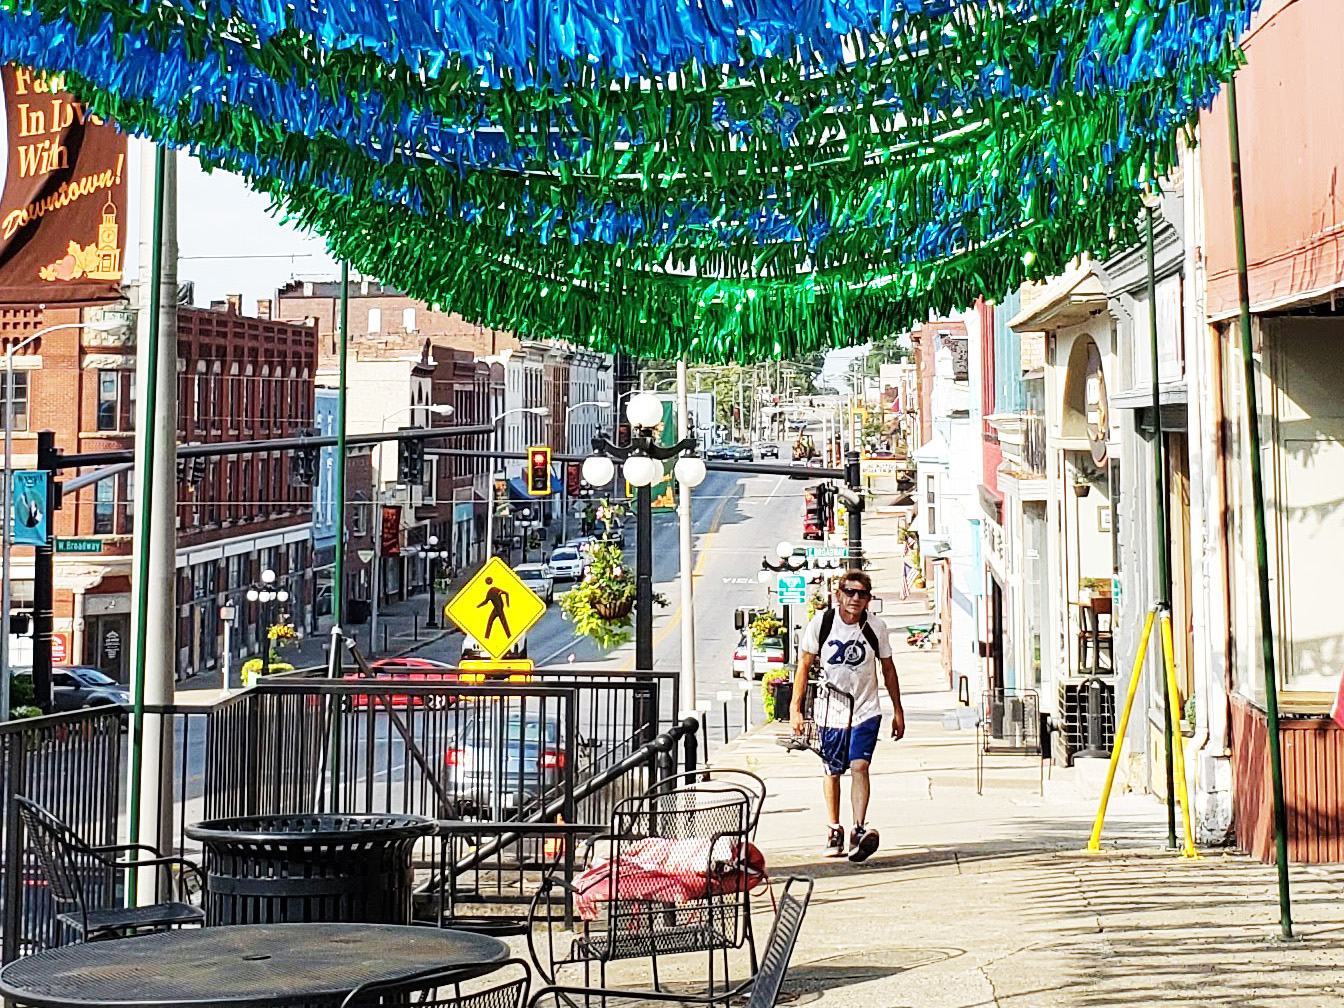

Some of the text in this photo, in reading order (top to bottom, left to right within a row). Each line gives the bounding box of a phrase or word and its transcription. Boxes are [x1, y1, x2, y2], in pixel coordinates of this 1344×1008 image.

[17, 103, 46, 137] In
[17, 135, 70, 178] With
[2, 153, 125, 240] Downtown!
[66, 541, 101, 552] Broadway
[827, 639, 867, 666] 20
